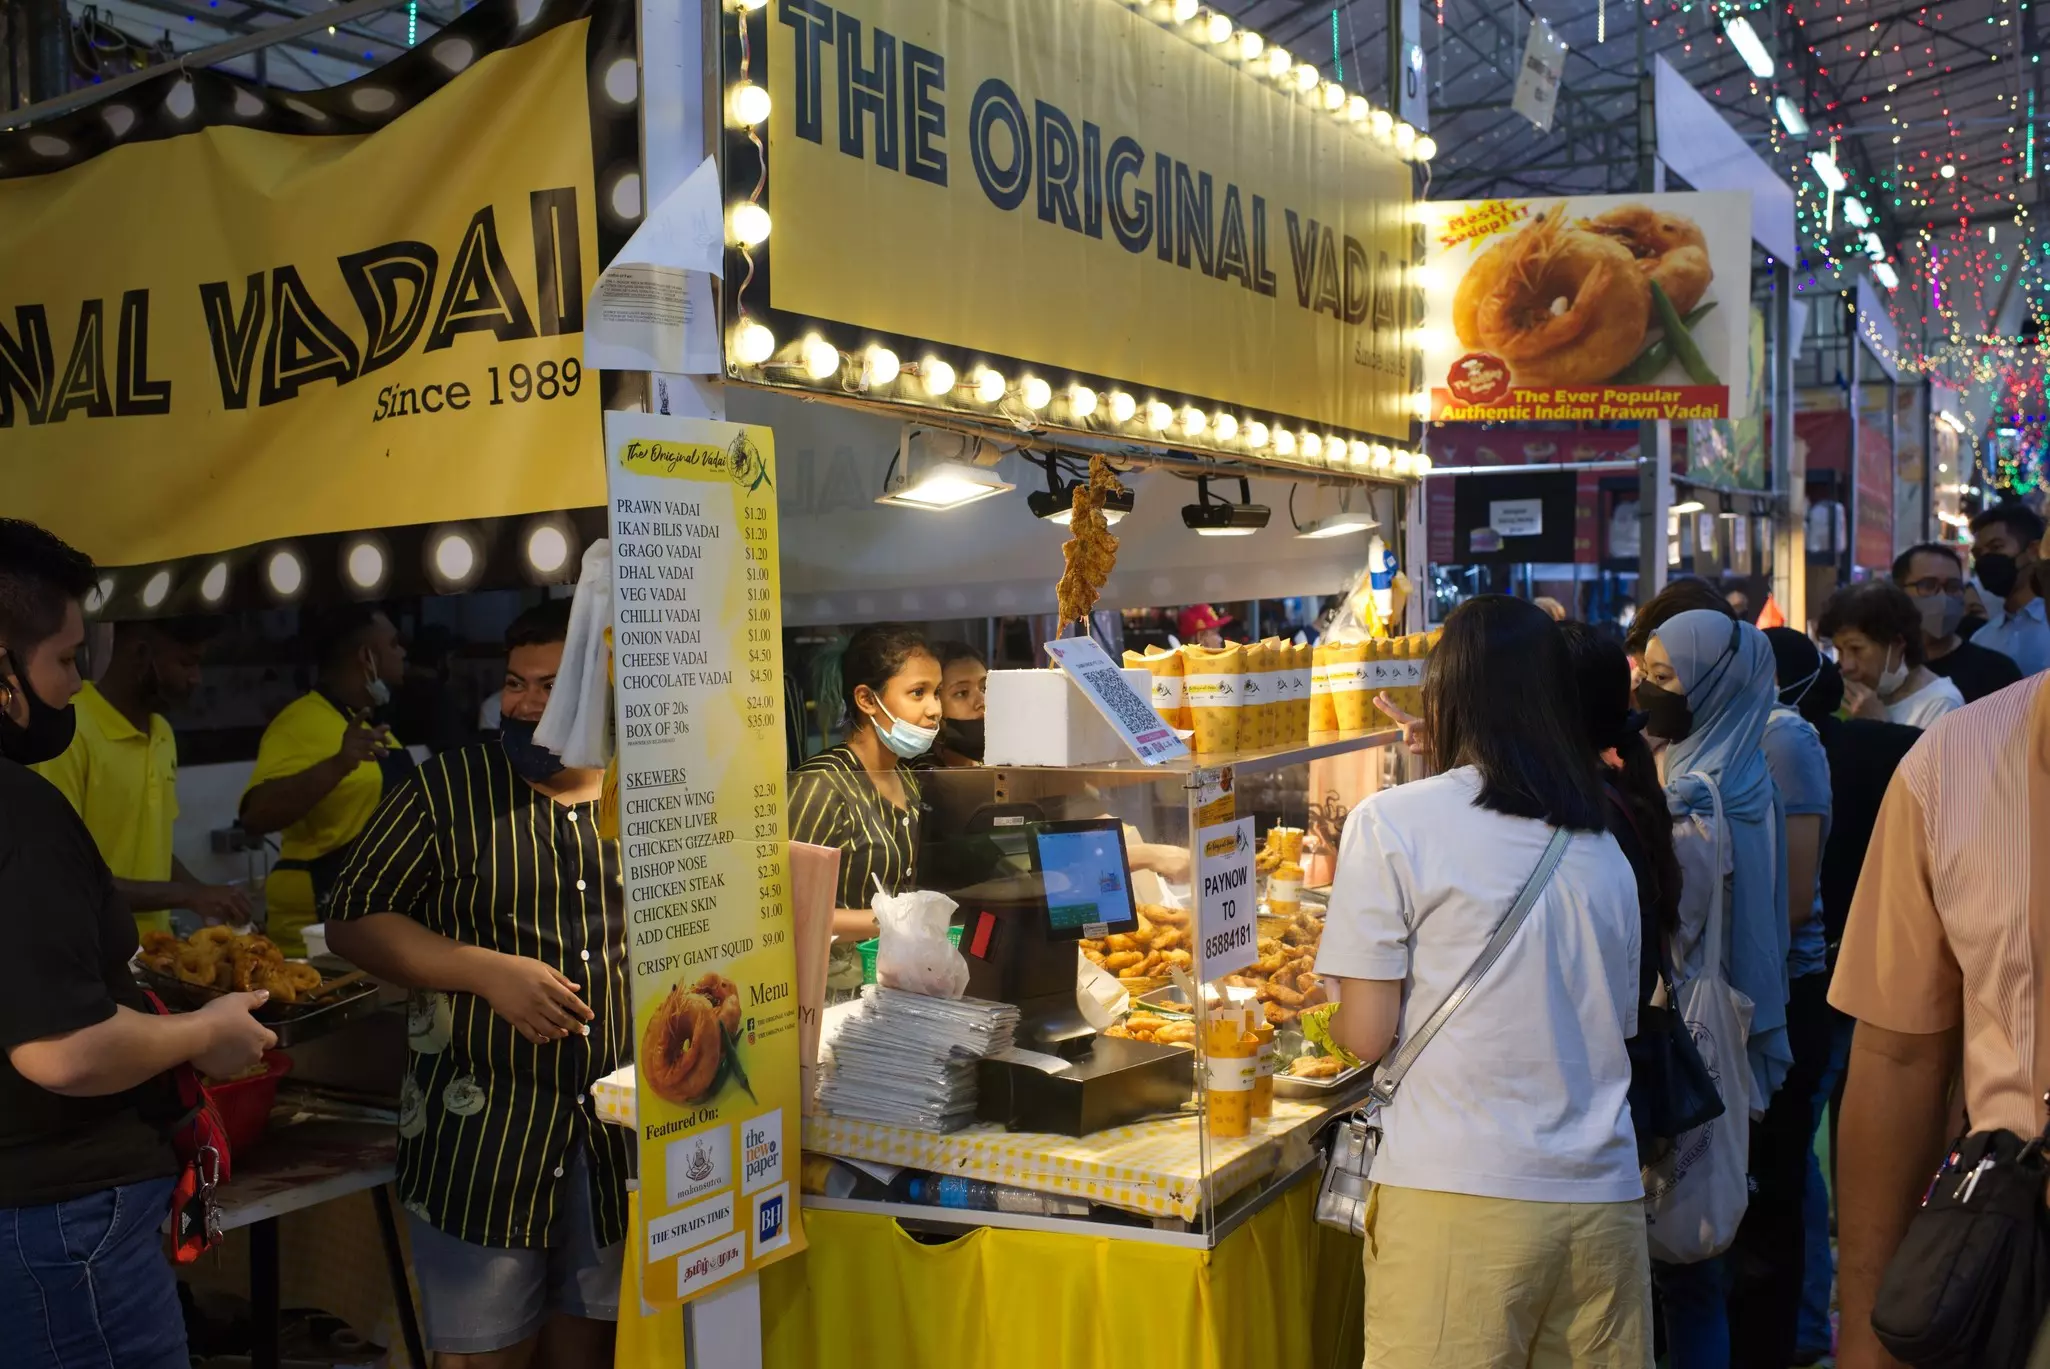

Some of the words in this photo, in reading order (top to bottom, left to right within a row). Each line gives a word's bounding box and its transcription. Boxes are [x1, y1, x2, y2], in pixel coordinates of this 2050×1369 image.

[778, 0, 949, 187] THE
[969, 78, 1277, 298] ORIGINAL
[200, 186, 585, 410] VADAI
[373, 374, 472, 423] Since
[488, 356, 583, 407] 1989
[1513, 389, 1554, 403] The
[1555, 390, 1599, 403] Ever
[1603, 389, 1682, 406] Popular
[1440, 404, 1530, 420] Authentic
[1535, 404, 1594, 419] Indian
[1599, 405, 1658, 419] Prawn
[1663, 404, 1719, 419] Vadai
[627, 442, 648, 461] The
[651, 444, 700, 473] Original
[702, 450, 727, 468] Vadai
[617, 499, 662, 515] PRAWN
[664, 501, 700, 517] VADAI
[744, 506, 767, 521] $1.20
[618, 521, 650, 536] IKAN
[653, 522, 683, 537] BILIS
[685, 524, 719, 539] VADAI
[745, 526, 767, 541] $1.20
[618, 543, 663, 558] GRAGO
[666, 545, 701, 559] VADAI
[745, 547, 768, 561] $1.20
[619, 565, 655, 580] DHAL
[658, 565, 694, 580] VADAI
[746, 567, 769, 582] $1.00
[620, 587, 647, 601] VEG
[650, 587, 686, 601] VADAI
[747, 587, 770, 602] $1.00
[620, 608, 662, 624] CHILLI
[665, 608, 700, 622] VADAI
[748, 608, 770, 622] $1.00
[621, 631, 663, 646] ONION
[666, 629, 700, 644] VADAI
[748, 628, 770, 643] $1.00
[622, 652, 669, 668] CHEESE
[673, 650, 708, 666] VADAI
[748, 648, 771, 663] $4.50
[623, 673, 696, 690] CHOCOLATE
[699, 670, 732, 686] VADAI
[750, 669, 772, 684] $4.50
[625, 703, 651, 719] BOX
[654, 702, 670, 716] OF
[671, 701, 689, 716] 20s
[746, 695, 774, 710] $24.00
[626, 723, 652, 739] BOX
[655, 721, 671, 736] OF
[673, 720, 689, 735] 30s
[748, 713, 774, 728] $35.00
[626, 768, 686, 788] SKEWERS
[626, 795, 685, 816] CHICKEN
[685, 791, 715, 807] WING
[753, 783, 776, 799] $2.30
[627, 816, 682, 837] CHICKEN
[685, 812, 718, 829] LIVER
[754, 803, 777, 818] $2.30
[628, 838, 683, 858] CHICKEN
[685, 830, 734, 849] GIZZARD
[755, 823, 778, 838] $2.30
[631, 860, 675, 881] BISHOP
[678, 855, 707, 872] NOSE
[756, 843, 779, 859] $2.30
[632, 881, 686, 902] CHICKEN
[689, 873, 725, 891] STEAK
[758, 863, 780, 879] $2.30
[1204, 865, 1248, 897] PAYNOW
[634, 903, 688, 924] CHICKEN
[691, 896, 717, 915] SKIN
[759, 884, 781, 899] $4.50
[1222, 899, 1236, 921] TO
[635, 927, 663, 946] ADD
[665, 918, 710, 939] CHEESE
[760, 903, 782, 919] $1.00
[637, 953, 680, 976] CRISPY
[683, 945, 719, 966] GIANT
[721, 938, 753, 957] SQUID
[763, 930, 785, 947] $9.00
[1205, 922, 1251, 959] 85884181
[750, 981, 788, 1007] Menu
[646, 1111, 696, 1140] Featured
[699, 1108, 718, 1123] On:
[745, 1128, 765, 1149] the
[746, 1143, 769, 1163] new
[746, 1152, 779, 1183] paper
[677, 1177, 722, 1199] makansutra
[651, 1229, 670, 1245] THE
[671, 1216, 706, 1238] STRAITS
[706, 1206, 730, 1225] TIMES
[761, 1203, 781, 1232] BH
